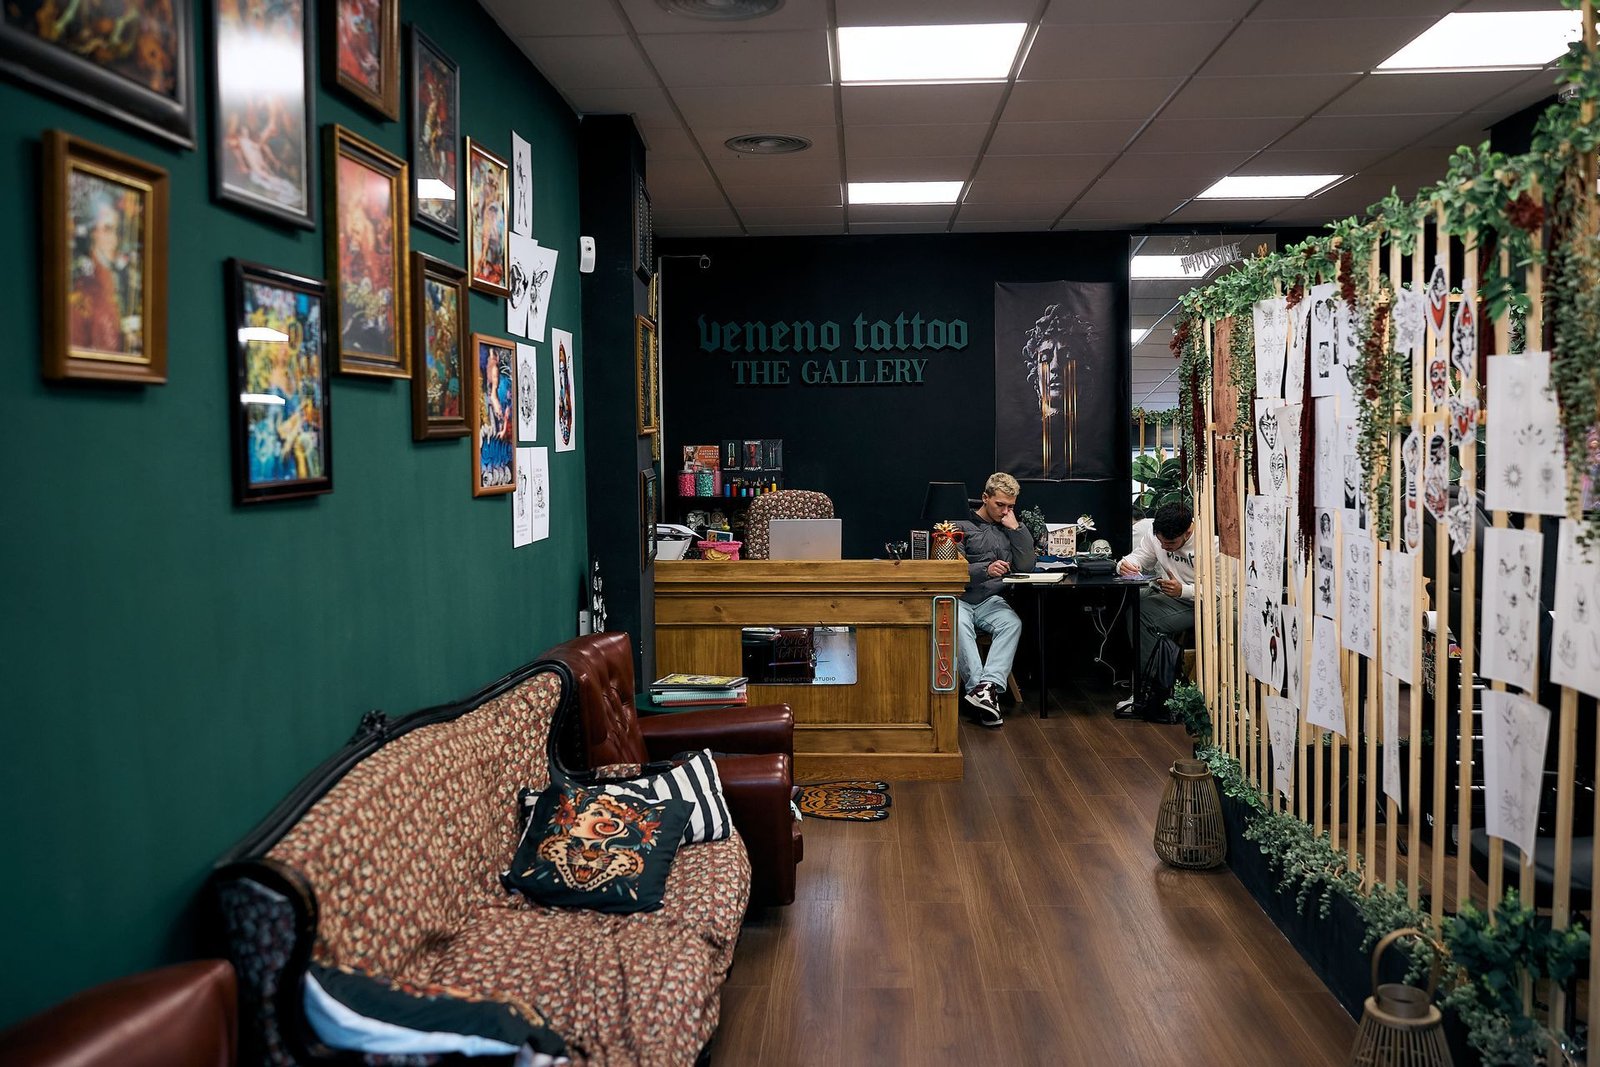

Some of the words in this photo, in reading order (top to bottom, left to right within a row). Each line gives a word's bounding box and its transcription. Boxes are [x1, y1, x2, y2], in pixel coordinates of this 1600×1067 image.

[697, 313, 841, 353] veneno
[852, 311, 969, 352] tattoo
[731, 360, 790, 385] THE
[801, 358, 929, 384] GALLERY
[937, 600, 952, 687] TATTOO
